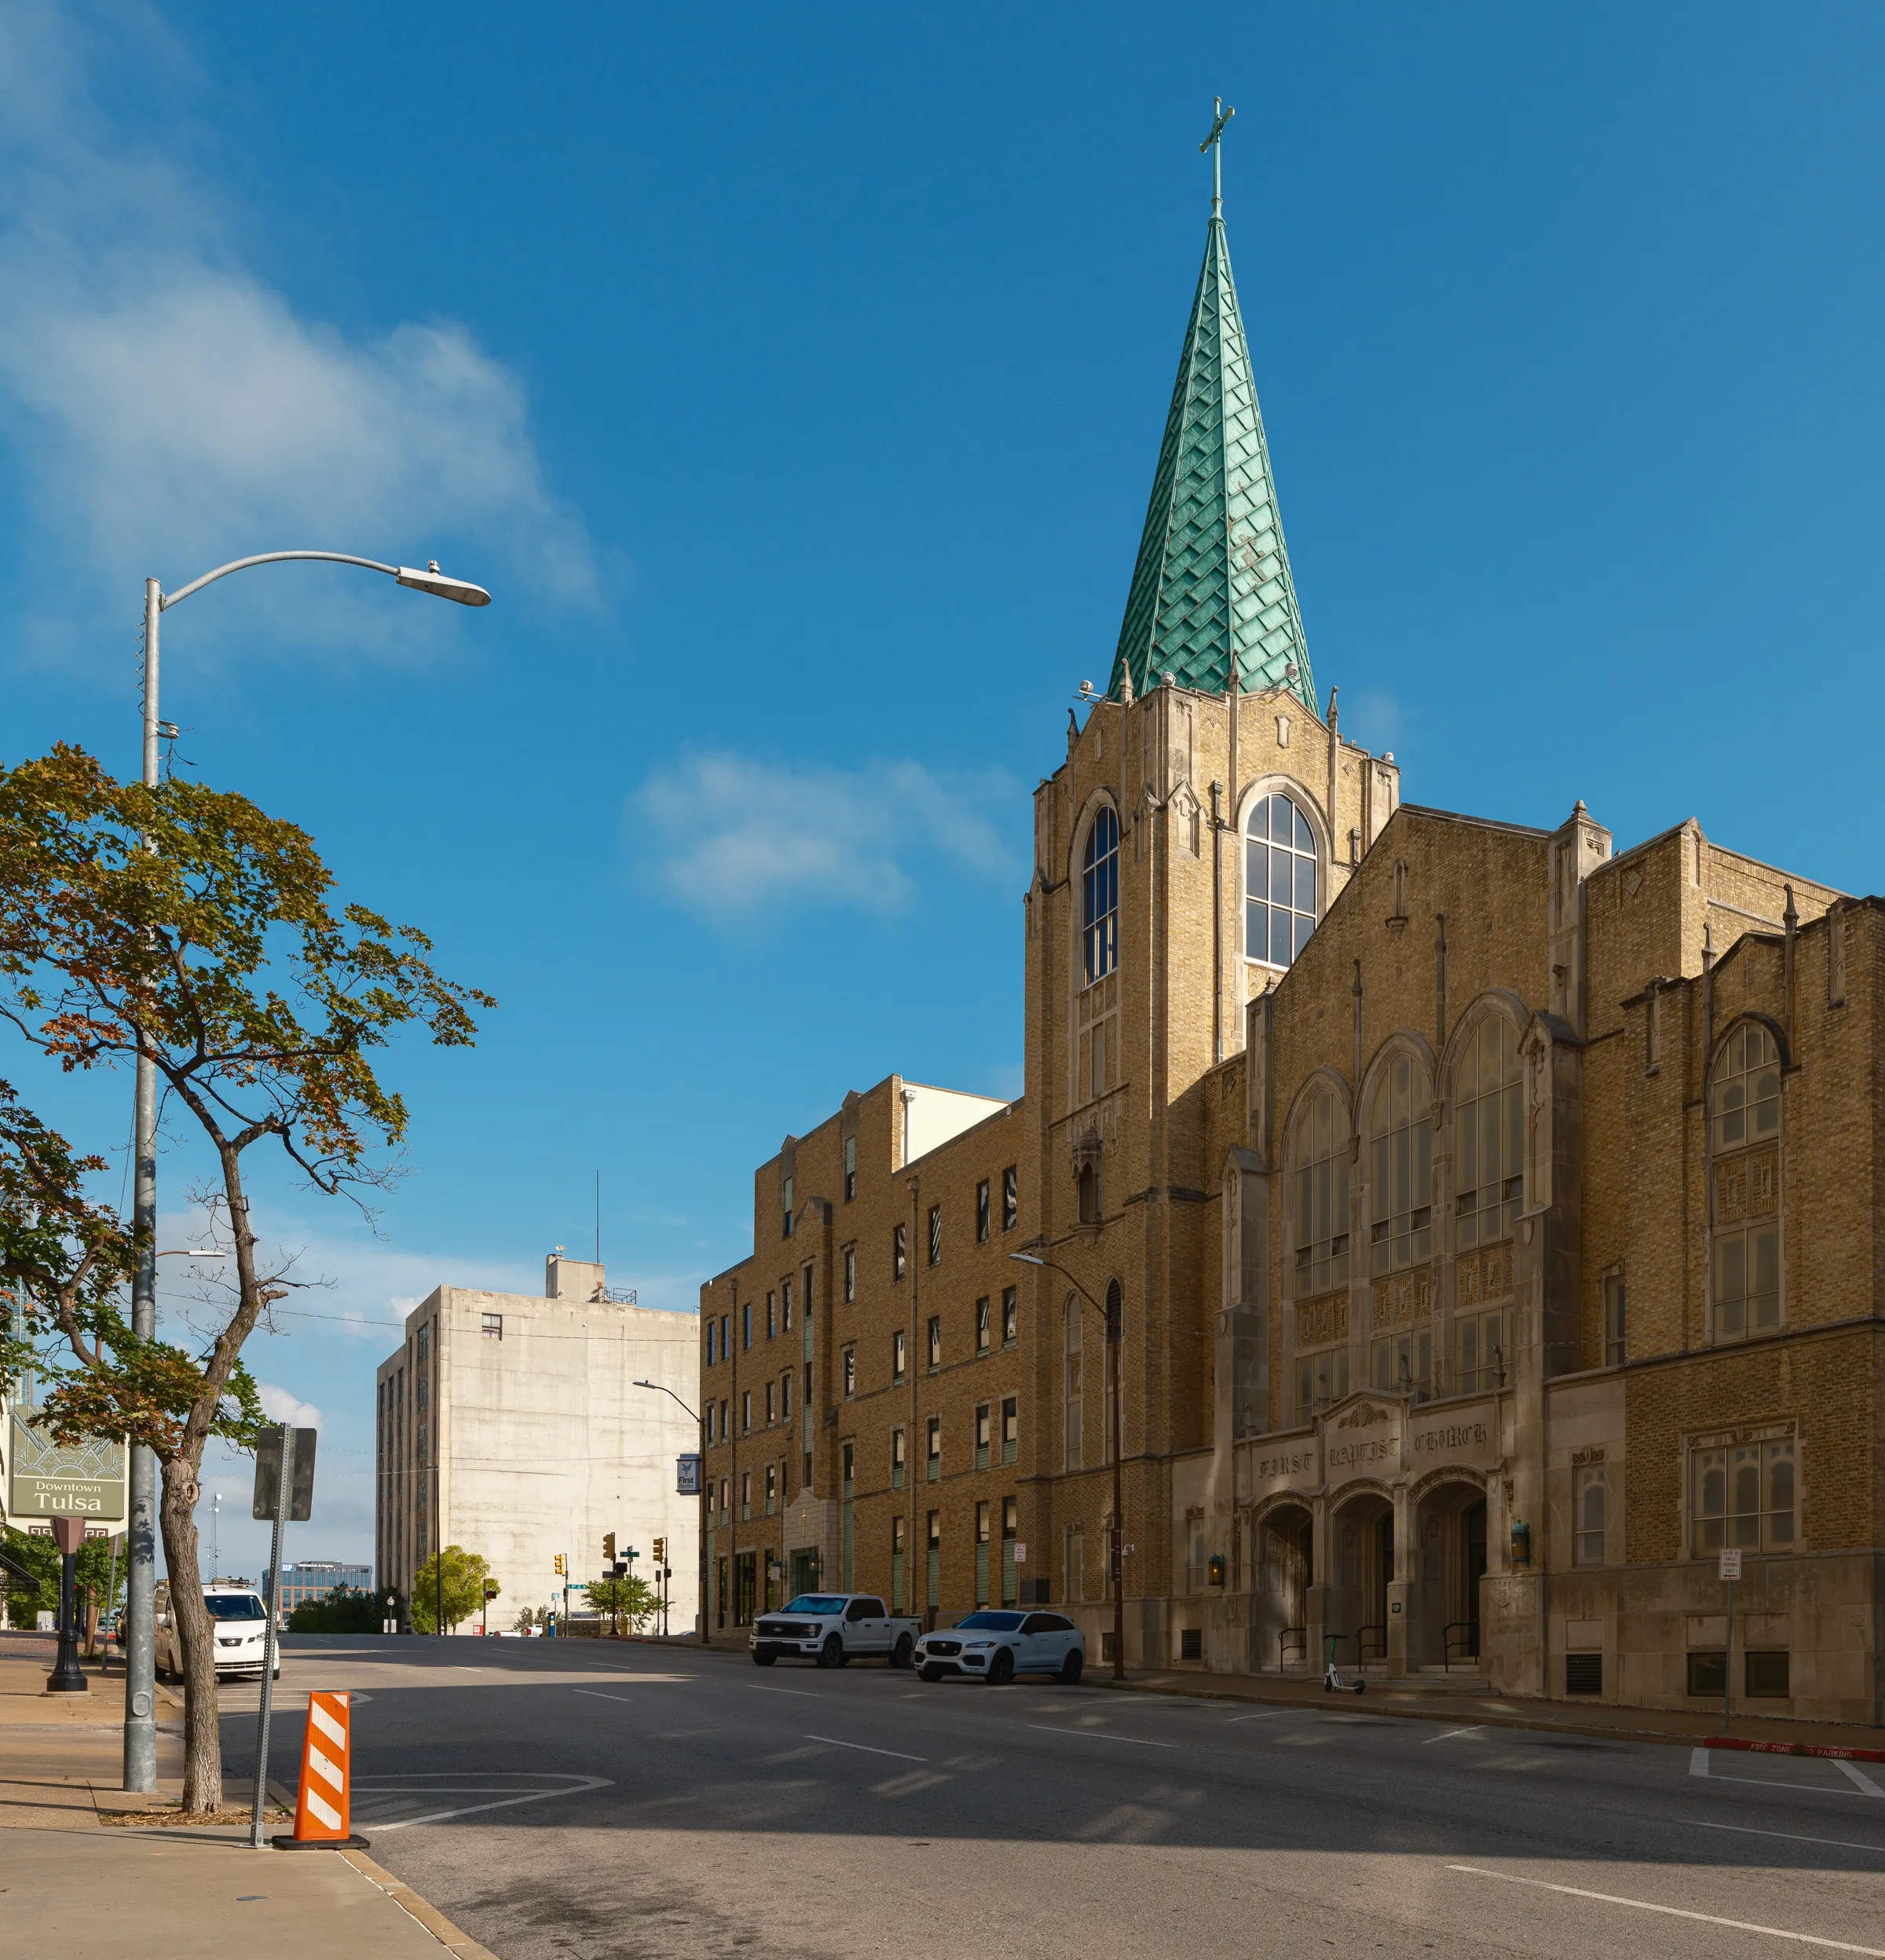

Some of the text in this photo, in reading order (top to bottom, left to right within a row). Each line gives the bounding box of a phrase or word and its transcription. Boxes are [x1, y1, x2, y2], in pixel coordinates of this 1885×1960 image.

[1257, 1423, 1487, 1480] FIRST BAPTIST CHURCH
[36, 1481, 101, 1493] Downtown
[34, 1493, 102, 1511] Tulsa
[1751, 1742, 1768, 1751] FIRE
[1771, 1744, 1792, 1753] ZONE
[1817, 1749, 1852, 1758] PARKING
